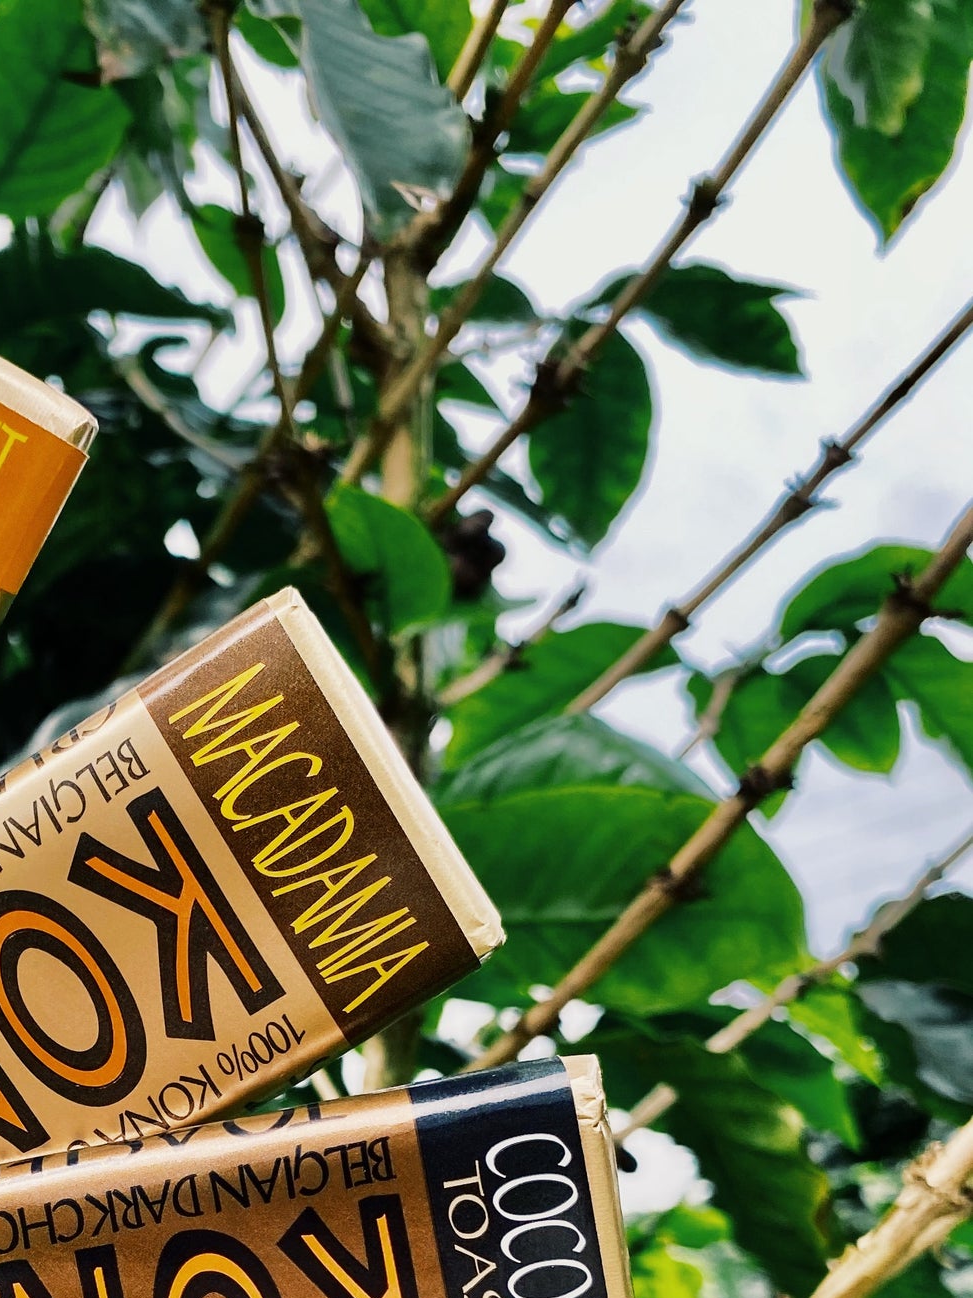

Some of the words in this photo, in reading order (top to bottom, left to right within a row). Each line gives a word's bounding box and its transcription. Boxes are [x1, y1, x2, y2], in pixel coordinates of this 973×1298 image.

[168, 662, 430, 1014] MACADAMIA
[217, 1013, 306, 1081] 100%
[88, 1173, 206, 1238] DARK
[214, 1136, 398, 1215] BELGIAN
